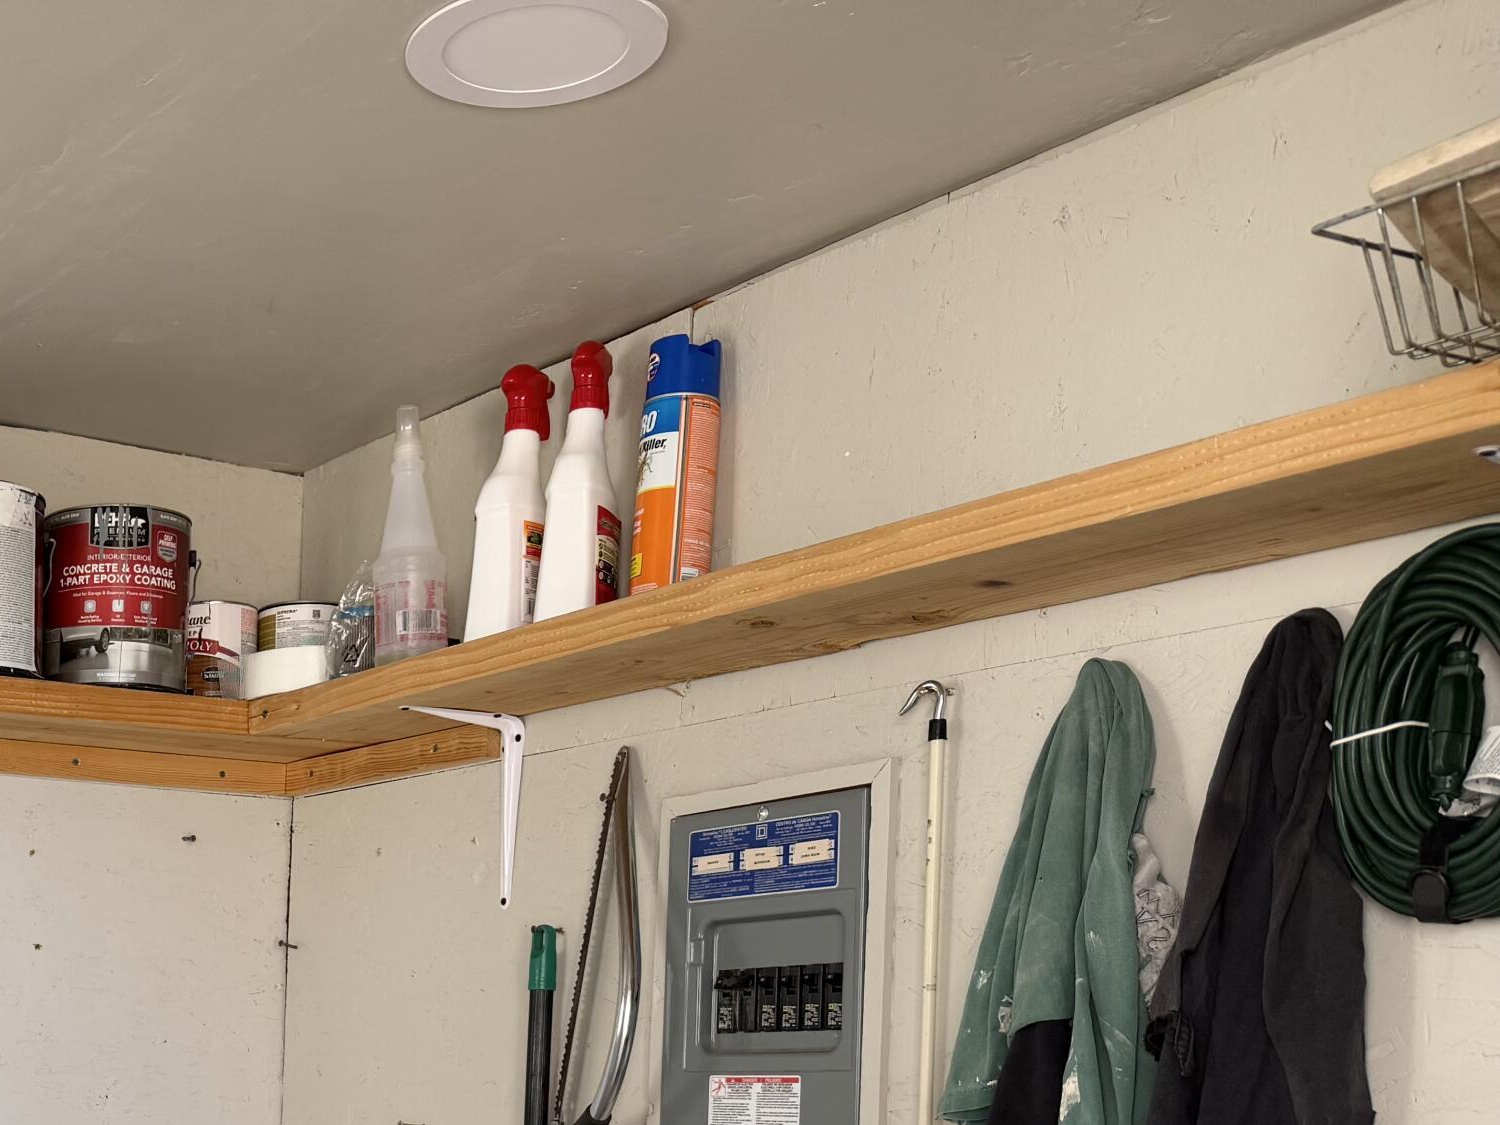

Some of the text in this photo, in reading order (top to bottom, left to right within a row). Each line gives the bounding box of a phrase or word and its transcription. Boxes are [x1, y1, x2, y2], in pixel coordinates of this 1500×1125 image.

[63, 562, 173, 579] CONCRETE & GARAGE
[60, 574, 176, 590] 1-PART EPOXY COATING
